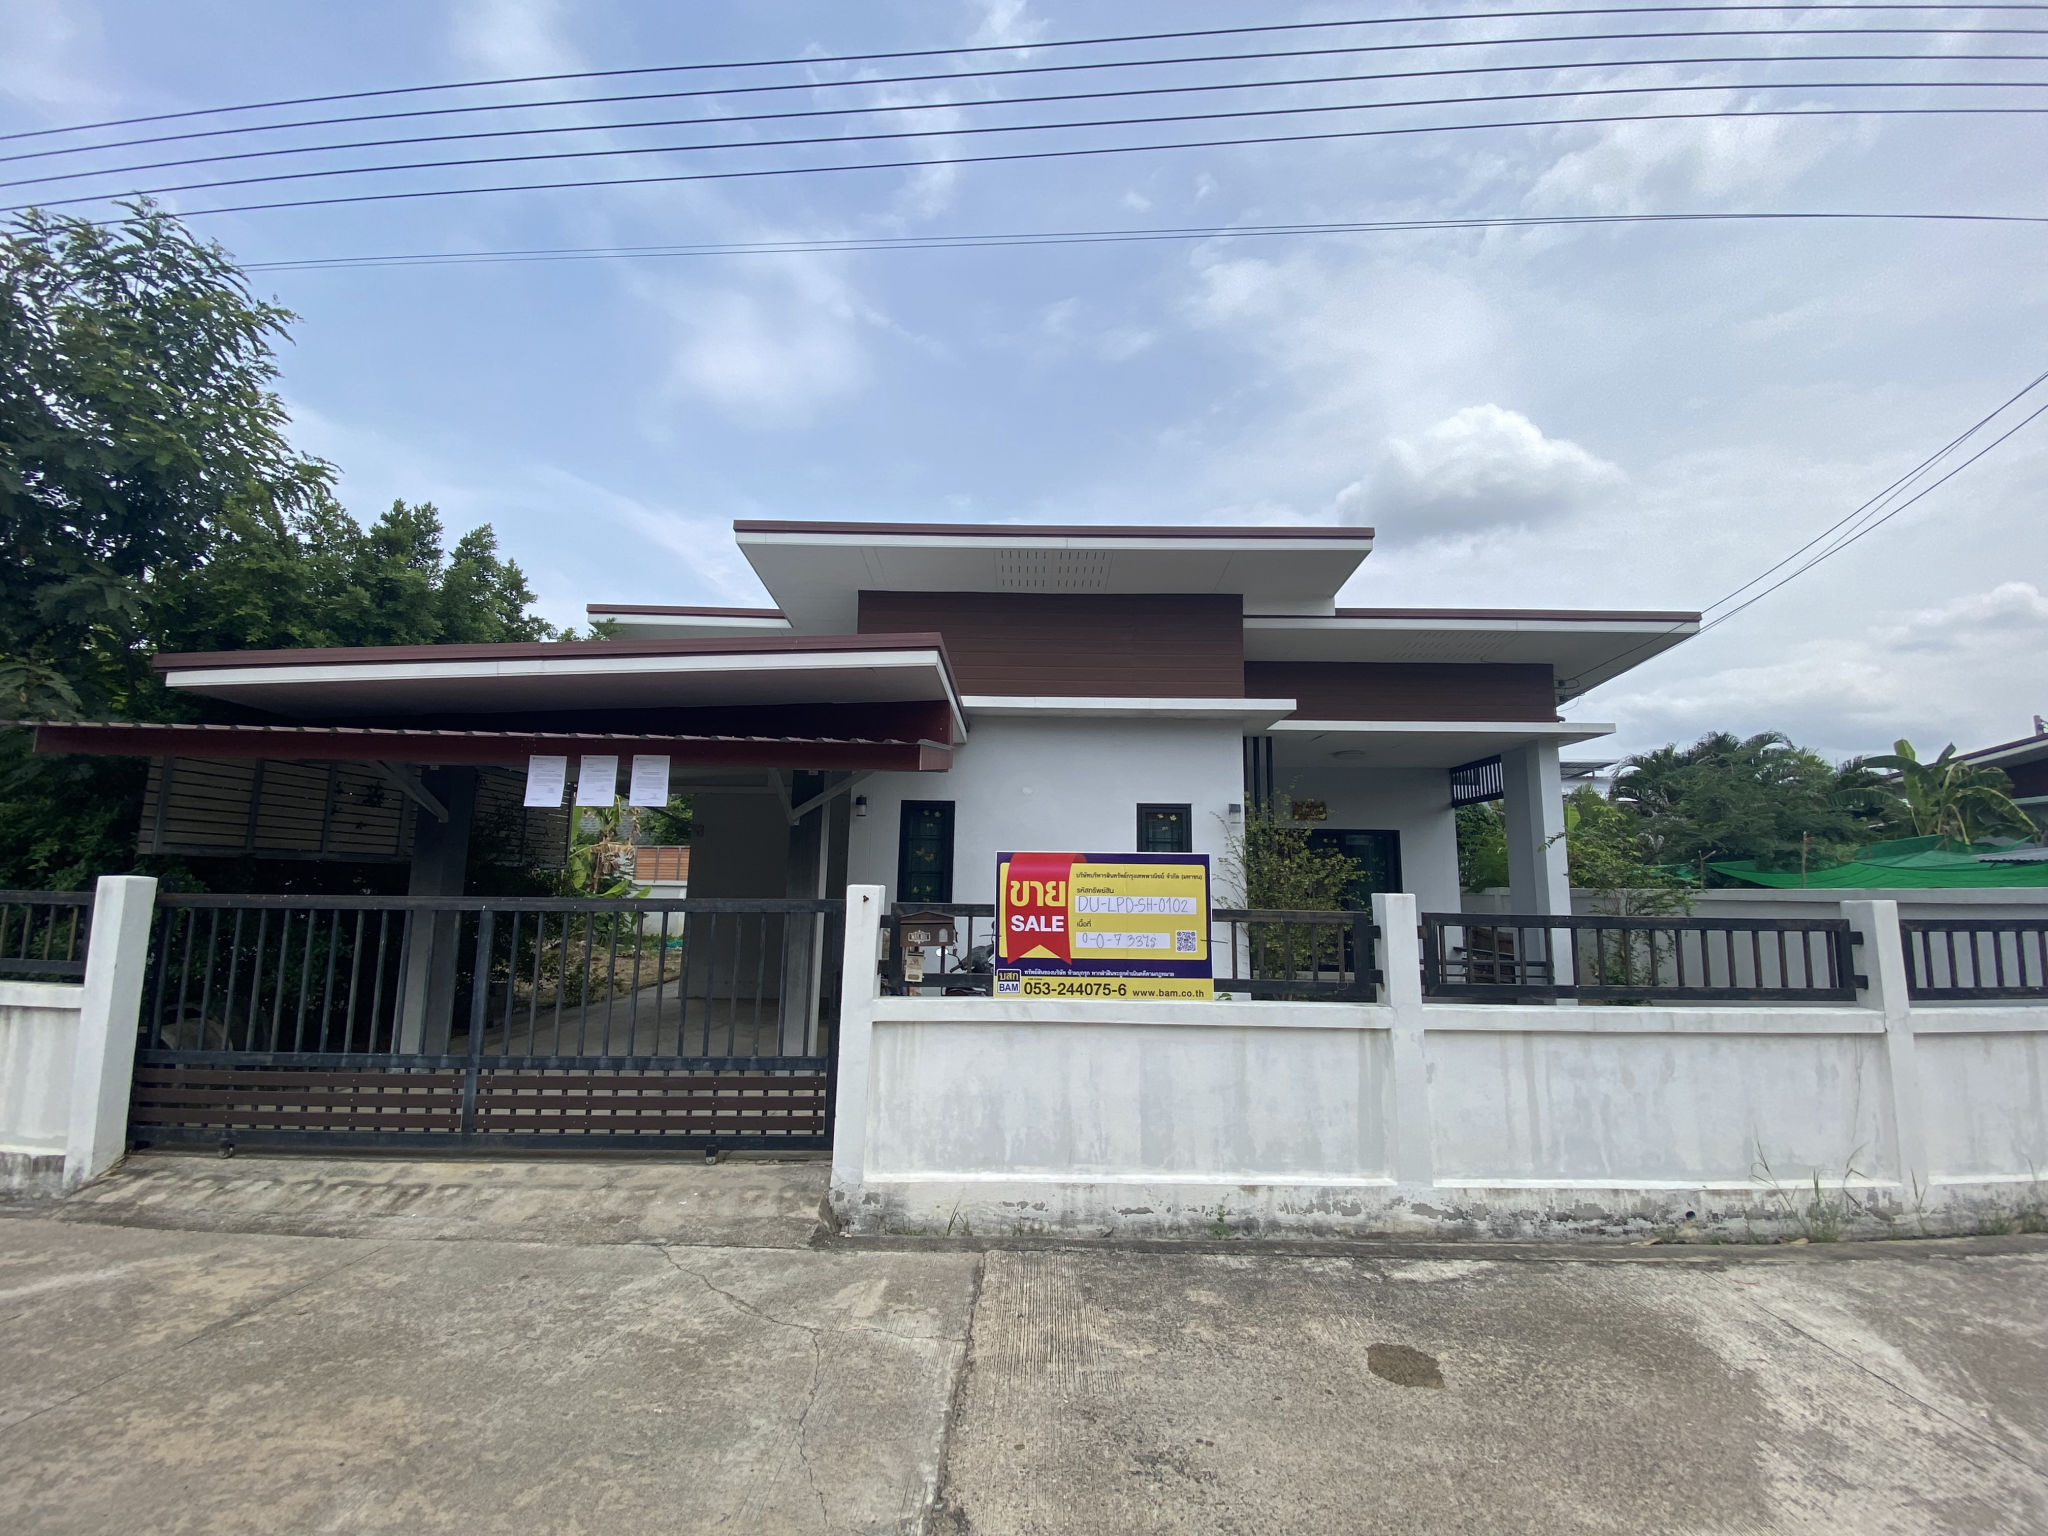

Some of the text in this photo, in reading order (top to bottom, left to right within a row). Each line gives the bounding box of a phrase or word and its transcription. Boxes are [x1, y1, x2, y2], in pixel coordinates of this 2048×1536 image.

[1010, 880, 1066, 907] ขาย
[1011, 915, 1065, 932] SALE
[1077, 918, 1092, 928] เนื้อที่
[999, 983, 1019, 992] BAM
[1024, 982, 1204, 997] 053-244075-6 www.bam.co.th
